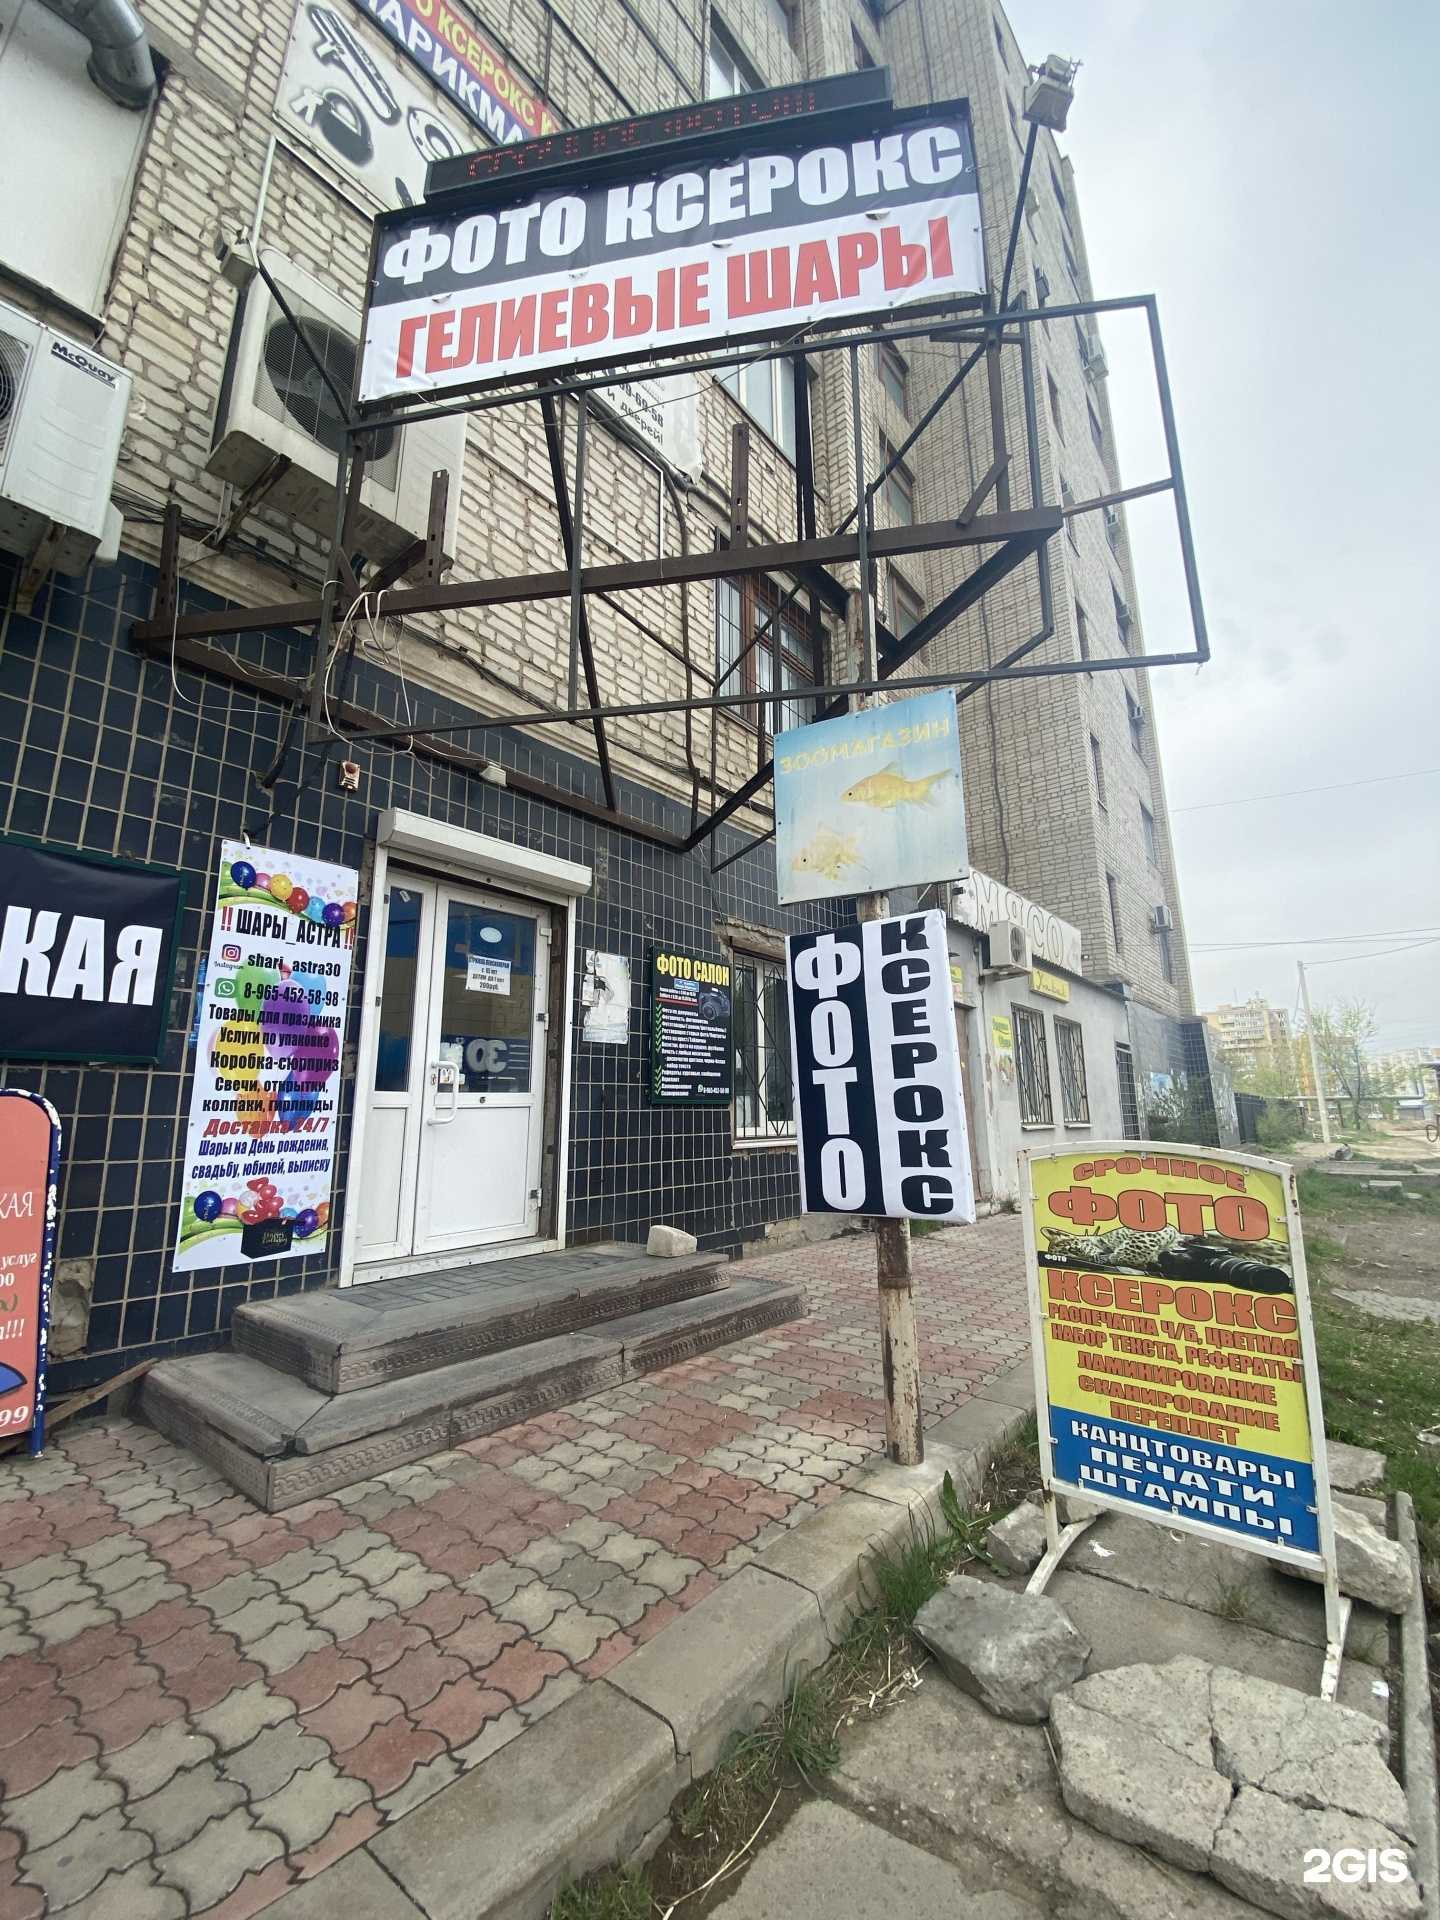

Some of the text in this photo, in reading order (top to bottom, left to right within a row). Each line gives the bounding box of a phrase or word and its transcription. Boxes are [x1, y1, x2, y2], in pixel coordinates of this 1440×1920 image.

[437, 5, 536, 128] КСЕРОКС
[383, 196, 588, 286] ФОТО
[604, 126, 964, 246] КСЕРОКС
[396, 215, 954, 379] ГЕЛИЕВЫЕ ШАРЫ
[52, 341, 116, 382] McQuay
[779, 718, 950, 774] ЗООМАГАЗИН
[0, 905, 164, 1006] КАЯ
[656, 953, 692, 982] ФОТО
[693, 960, 731, 988] САЛОН
[209, 1004, 342, 1029] Товары для праздника
[243, 981, 340, 1007] 8-965-452-58-98
[210, 1051, 340, 1073] Коробка-сюрприз
[219, 1027, 330, 1048] Услуги по упаковке
[881, 916, 954, 1215] КСЕРОКС
[214, 1076, 329, 1094] Свечи, открытки,
[794, 933, 867, 1211] ФОТО
[202, 1099, 334, 1113] колпаки, гирлянды
[202, 1116, 331, 1138] Доставка 24/7
[191, 1157, 331, 1181] свадьбу, юбилей, выписку
[198, 1138, 330, 1158] Шары на День рождения,
[1073, 1156, 1247, 1194] СРОЧНОЕ
[1048, 1185, 1271, 1241] ФОТО
[1044, 1253, 1067, 1264] ФОТО
[1047, 1269, 1298, 1334] КСЕРОКС
[1048, 1302, 1299, 1359] РАСПЕЧАТКА Ч/Б, ЦВЕТНАЯ
[1051, 1323, 1302, 1383] НАБОР ТЕКСТА, РЕФЕРАТЫ
[1077, 1350, 1278, 1406] ЛАМИНИРОВАНИЕ
[1078, 1374, 1281, 1432] СКАНИРОВАНИЕ
[1110, 1401, 1240, 1445] ПЕРЕПЛЕТ
[1071, 1419, 1297, 1489] КАНЦТОВАРЫ
[1090, 1447, 1276, 1507] ПЕЧАТИ
[1079, 1464, 1293, 1536] ШТАМПЫ
